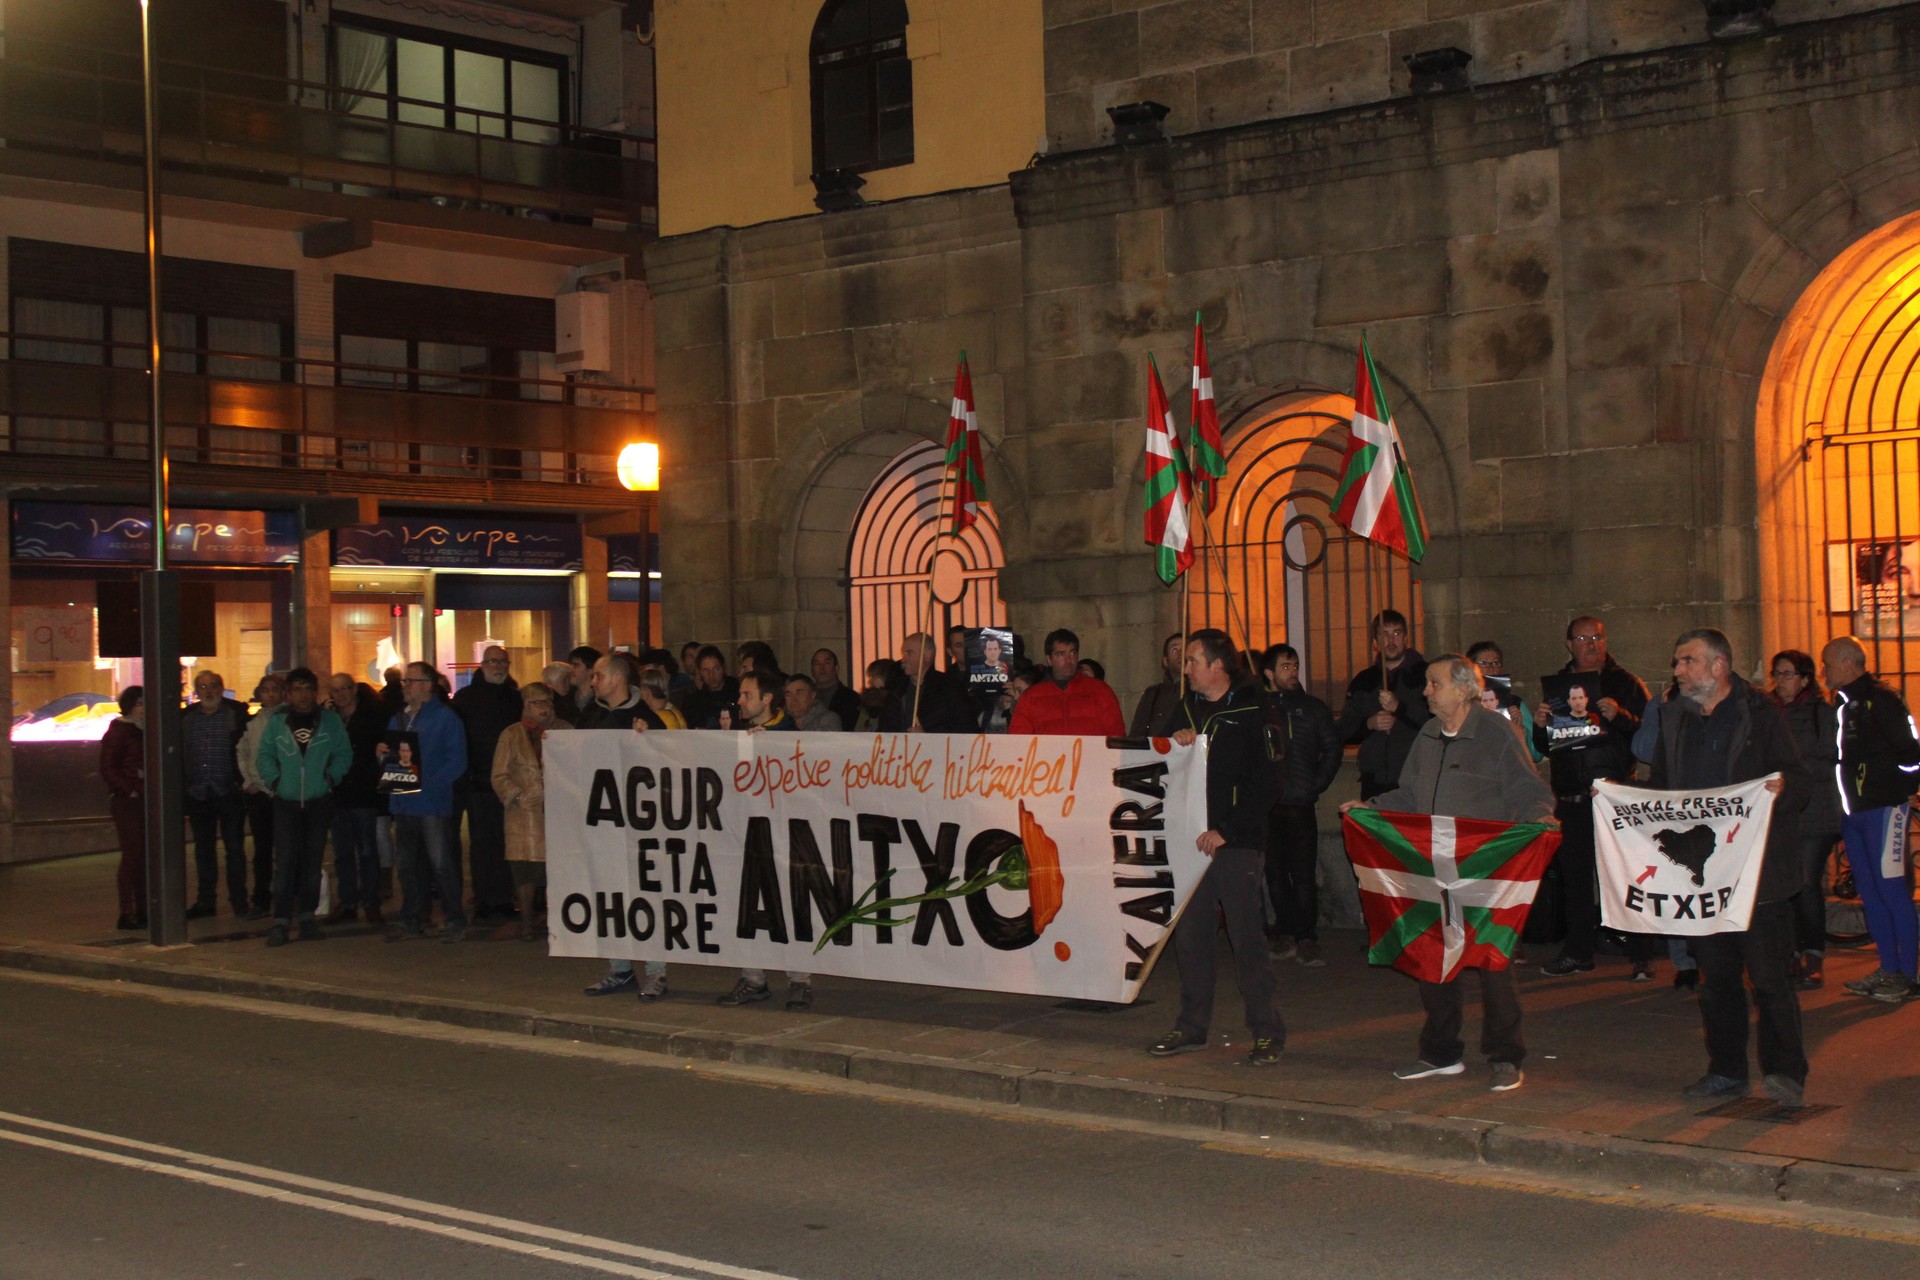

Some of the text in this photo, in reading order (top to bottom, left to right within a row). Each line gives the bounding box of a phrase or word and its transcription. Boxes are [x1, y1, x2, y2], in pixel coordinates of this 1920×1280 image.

[970, 673, 1008, 682] ANTXO
[1552, 725, 1601, 740] ANTXO
[381, 772, 417, 782] ANTXO
[586, 766, 723, 831] AGUR
[1613, 796, 1743, 817] EUSKAL PRESO
[1612, 805, 1753, 830] ETA IHESLARIAK
[1893, 812, 1905, 863] LAZKAO
[638, 838, 717, 896] ETA
[1625, 880, 1738, 919] ETXER
[561, 892, 720, 954] OHORE
